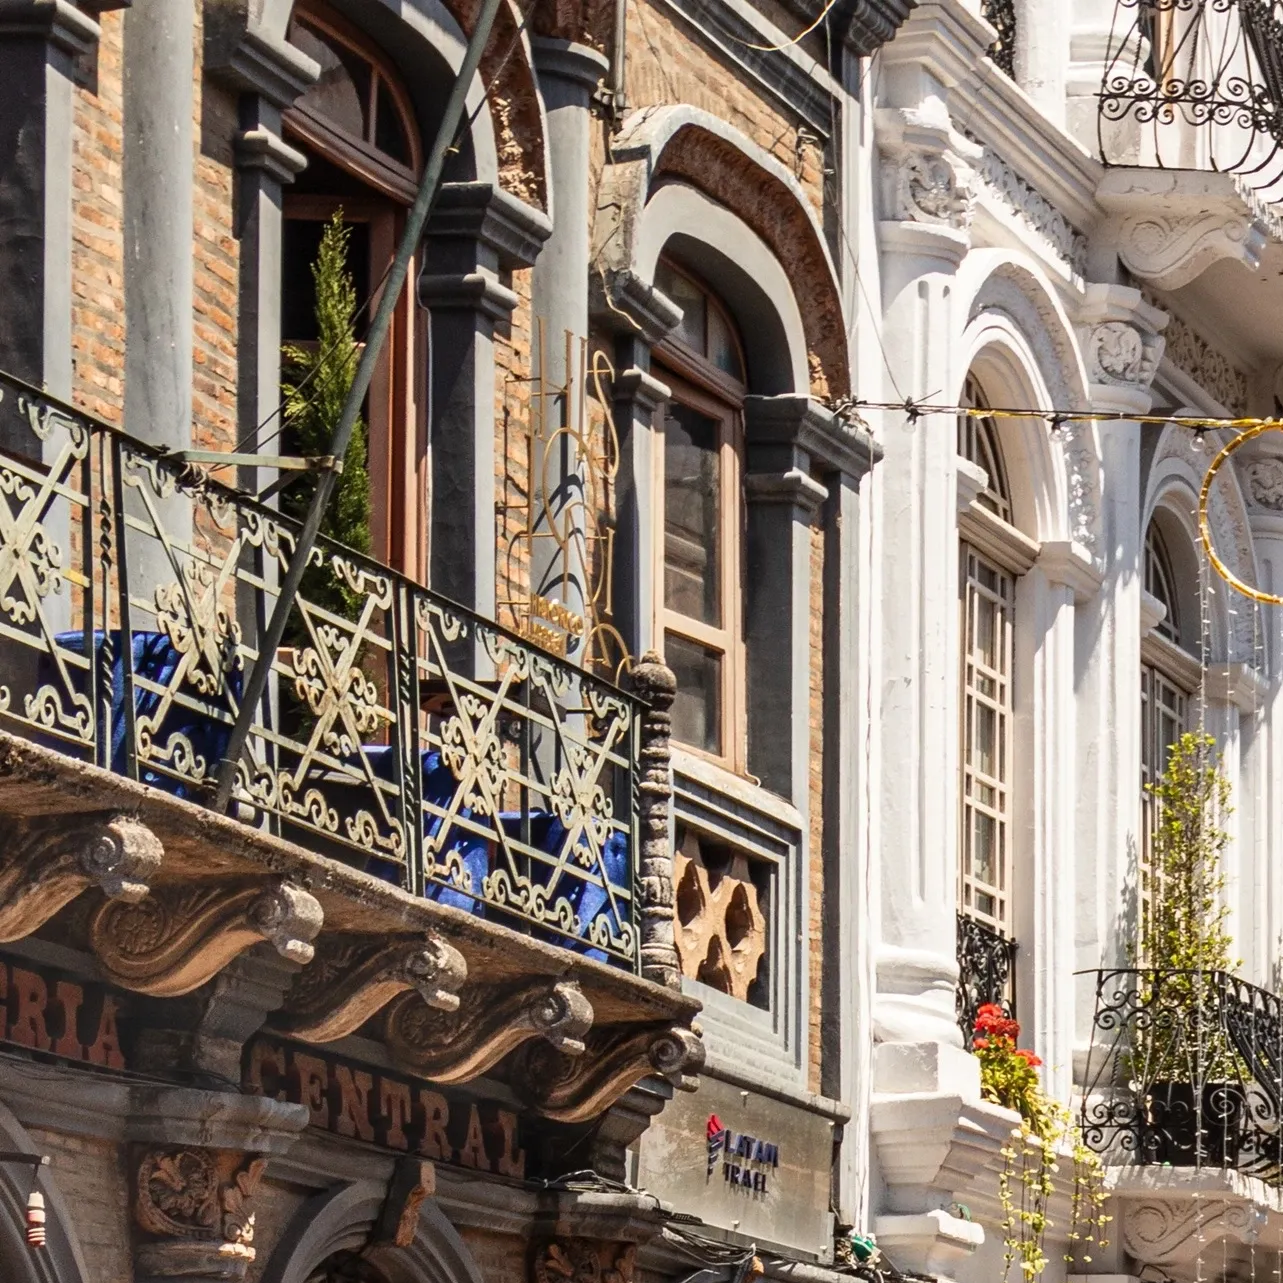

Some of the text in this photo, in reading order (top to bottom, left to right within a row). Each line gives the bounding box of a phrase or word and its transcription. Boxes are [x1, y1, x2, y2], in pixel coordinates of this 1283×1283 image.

[0, 962, 526, 1179] RIA CENTRAL
[724, 1130, 778, 1168] LATAM
